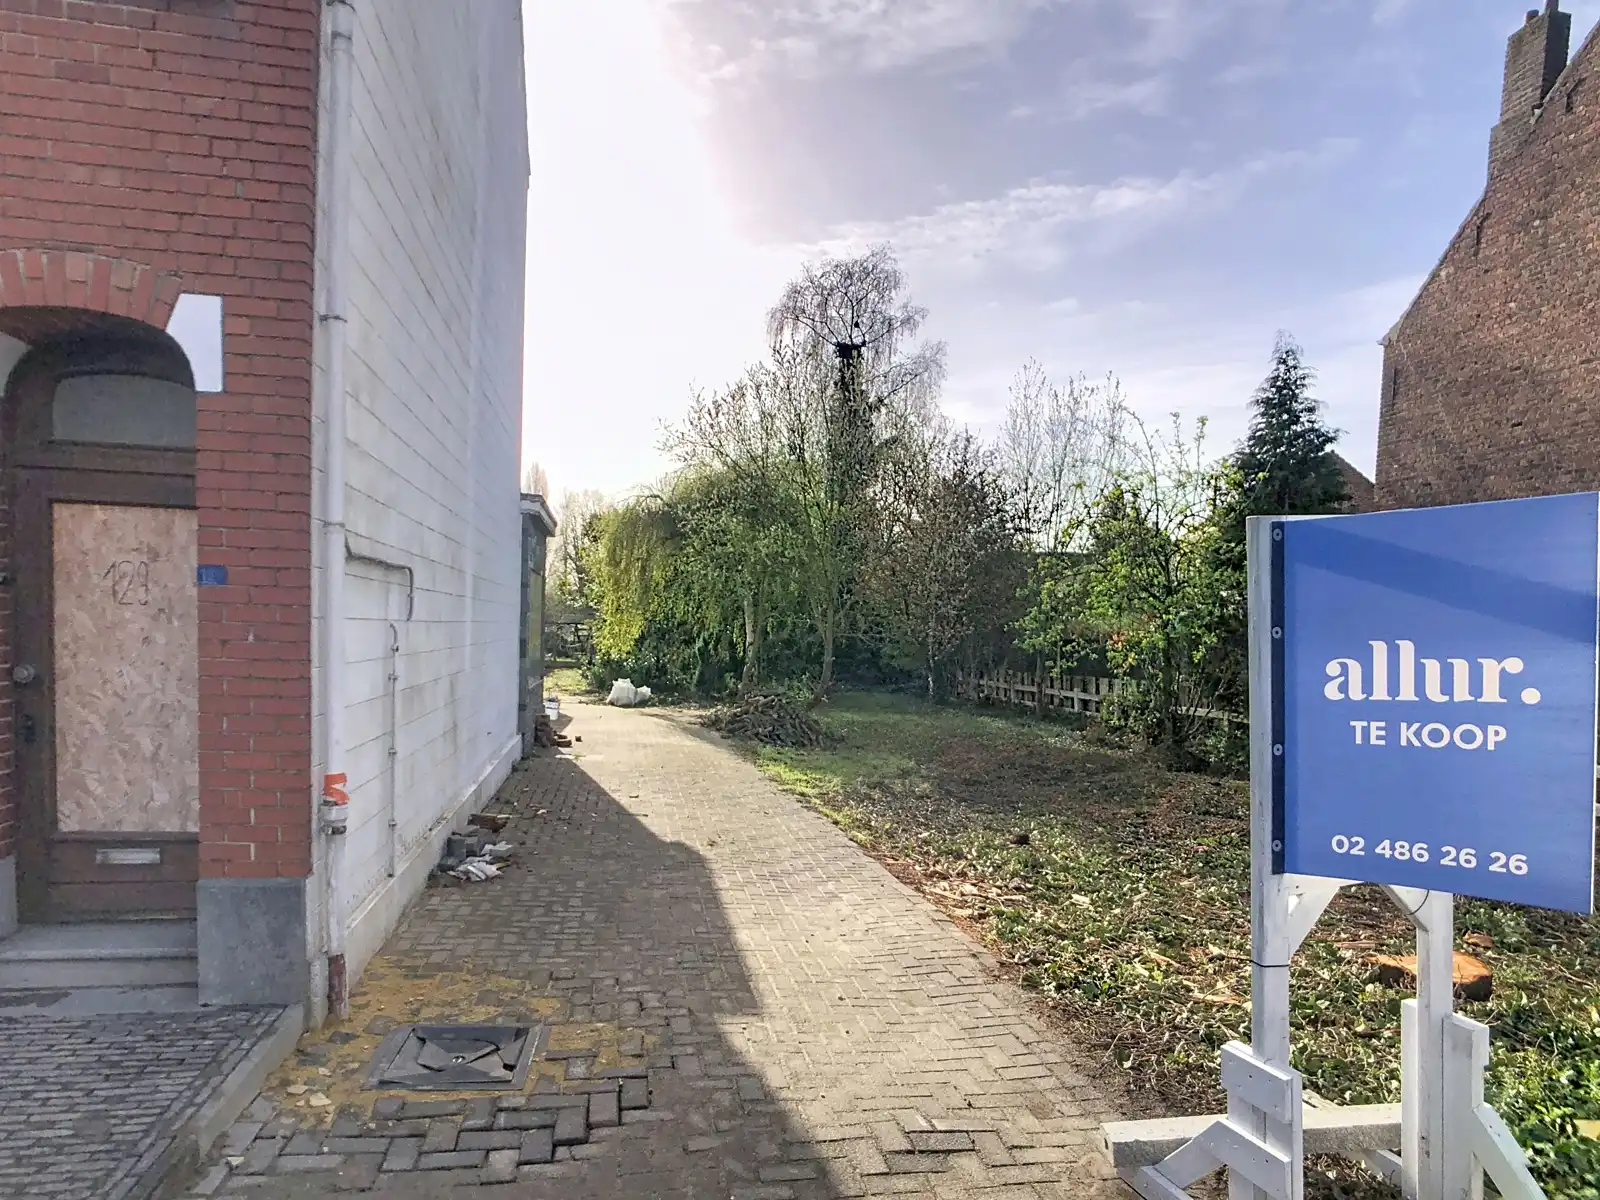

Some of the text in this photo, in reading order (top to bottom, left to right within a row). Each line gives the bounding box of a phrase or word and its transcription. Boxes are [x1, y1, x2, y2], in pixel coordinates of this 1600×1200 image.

[1323, 640, 1542, 704] allur.
[1350, 720, 1508, 751] TE KOOP
[1331, 834, 1529, 876] 02 486 26 26
